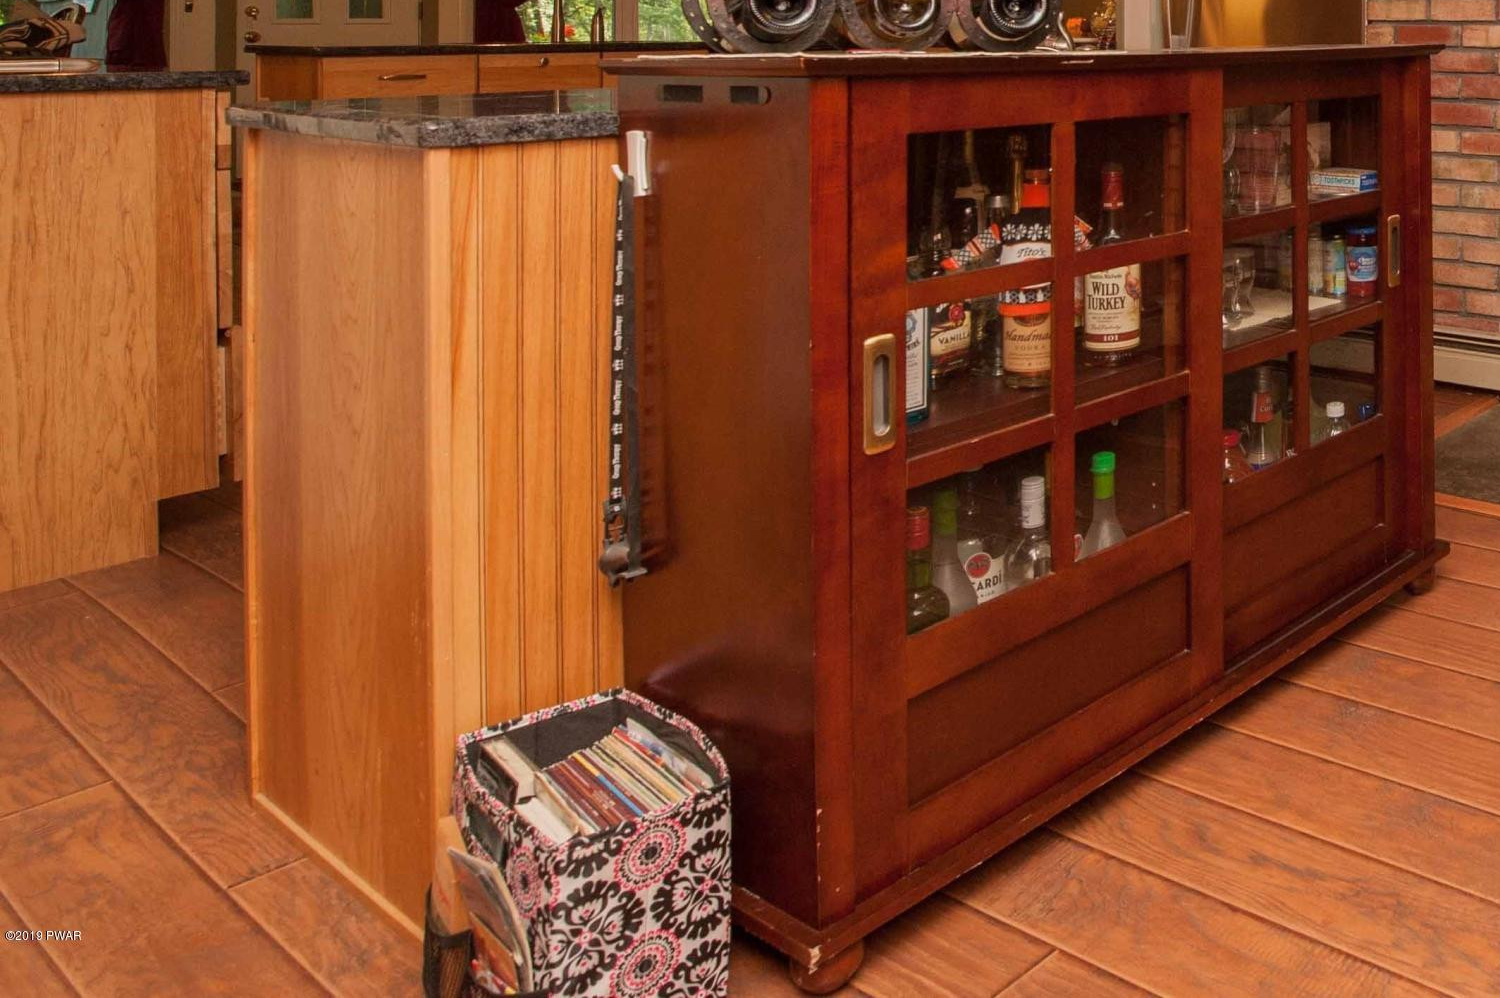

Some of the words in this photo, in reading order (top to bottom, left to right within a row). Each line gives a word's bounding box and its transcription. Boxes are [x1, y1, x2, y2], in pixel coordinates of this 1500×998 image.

[1016, 247, 1047, 258] Tito's
[1091, 281, 1121, 297] WILD
[1087, 294, 1127, 311] TURKEY
[1005, 328, 1051, 343] Handma
[977, 570, 1002, 591] ARDI
